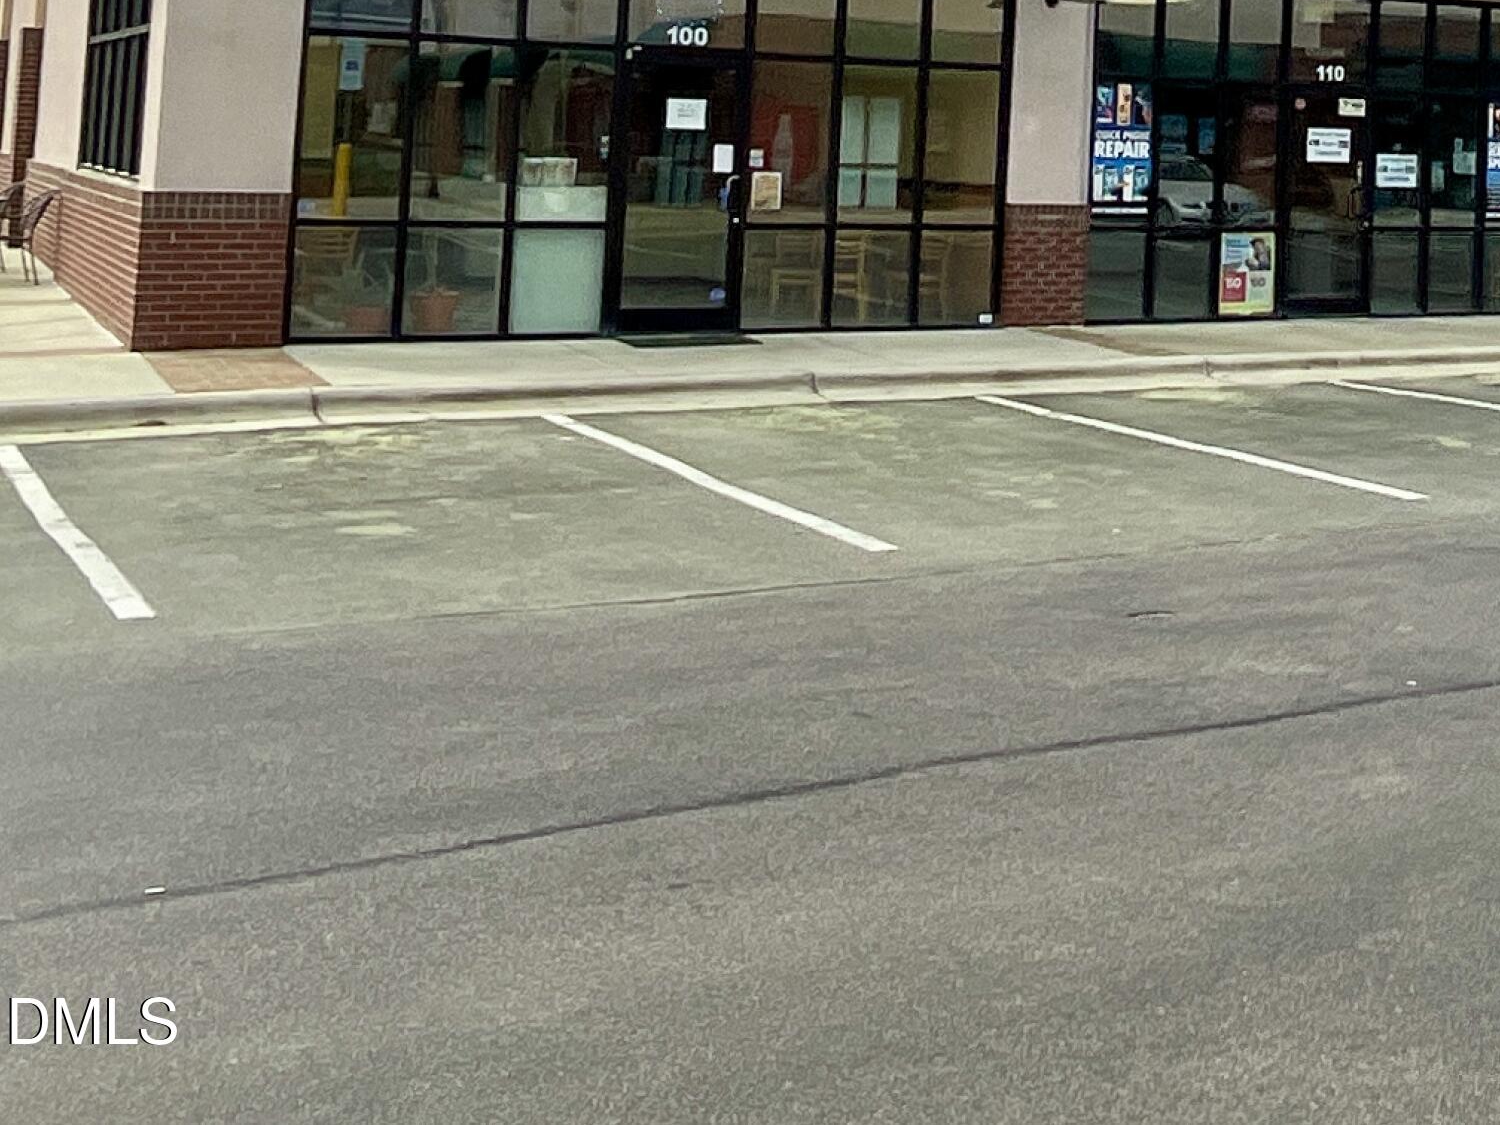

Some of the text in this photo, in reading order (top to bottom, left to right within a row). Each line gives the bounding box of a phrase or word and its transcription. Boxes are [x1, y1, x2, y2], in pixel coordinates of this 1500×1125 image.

[666, 25, 709, 46] 100
[1316, 64, 1345, 82] 110
[1094, 139, 1152, 158] REPAIR
